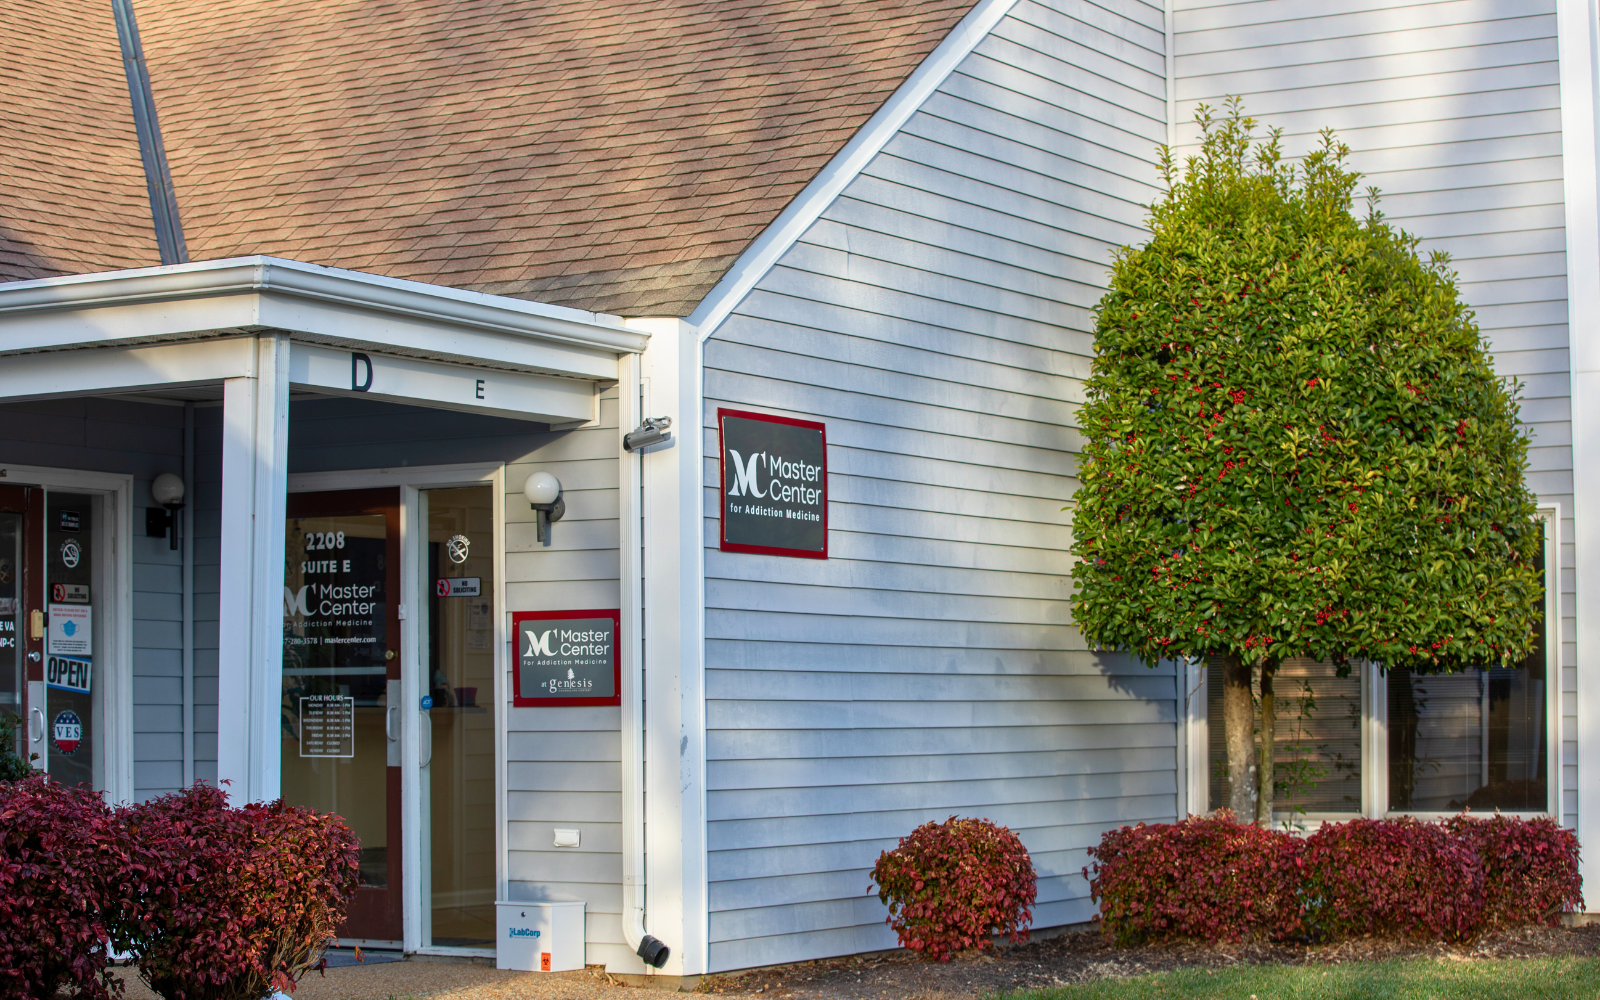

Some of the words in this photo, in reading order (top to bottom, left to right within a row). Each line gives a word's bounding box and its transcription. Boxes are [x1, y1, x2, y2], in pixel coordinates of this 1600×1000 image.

[352, 352, 373, 392] D
[476, 379, 485, 399] E
[770, 455, 821, 482] Master
[770, 479, 821, 505] Center
[730, 503, 742, 513] for
[745, 504, 783, 518] Addiction
[786, 509, 820, 522] Medicine
[306, 531, 345, 550] 2208
[301, 560, 337, 573] SUITE
[343, 560, 351, 572] E
[320, 583, 376, 599] Master
[320, 600, 376, 616] Center
[5, 621, 15, 631] VA
[293, 620, 332, 628] Addiction
[336, 619, 372, 627] Medicine
[324, 636, 376, 644] mastercenter.com
[561, 629, 610, 642] Master
[561, 643, 610, 656] Center
[47, 656, 88, 689] OPEN
[549, 678, 593, 693] genesis
[56, 727, 80, 738] VES
[513, 928, 540, 938] LabCorp
